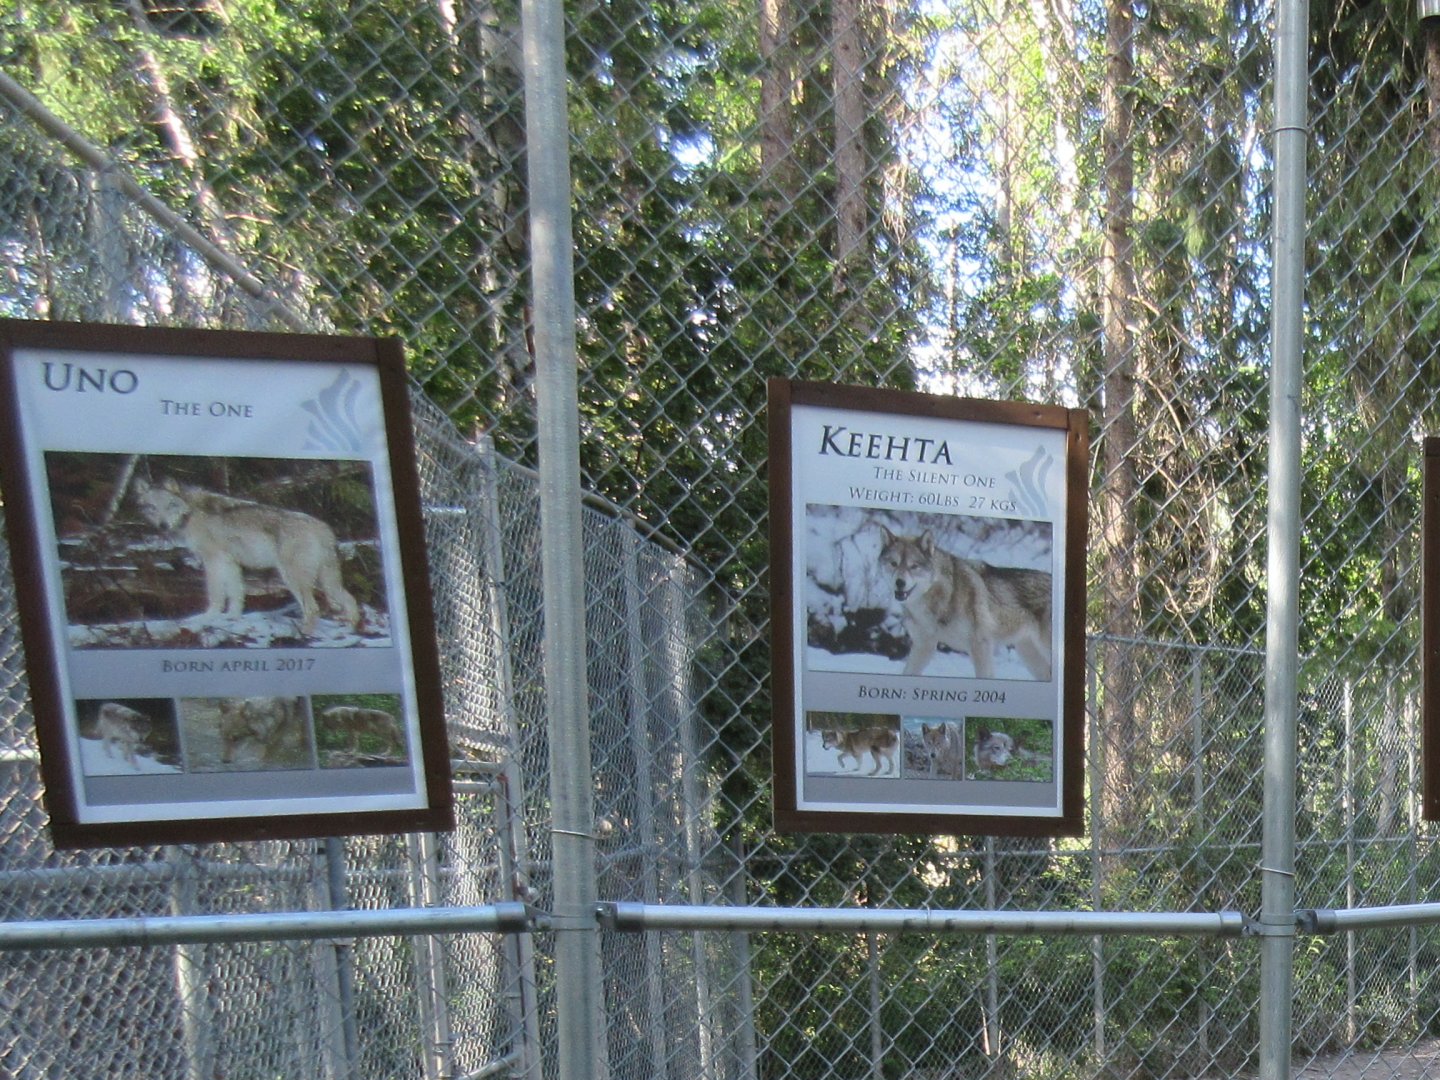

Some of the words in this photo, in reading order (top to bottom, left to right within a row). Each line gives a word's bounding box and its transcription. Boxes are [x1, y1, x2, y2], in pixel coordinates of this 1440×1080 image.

[42, 361, 139, 395] UNO
[160, 399, 200, 417] THE
[209, 401, 253, 418] ONE
[818, 425, 954, 465] KEEHTA
[873, 466, 903, 481] THE
[909, 469, 959, 486] SILENT
[963, 474, 996, 489] ONE
[849, 486, 914, 504] WEIGHT:
[918, 492, 960, 507] 60LBS
[968, 496, 986, 509] 27
[990, 499, 1017, 512] KGS
[162, 659, 213, 673] BORN
[221, 659, 269, 672] APRIL
[276, 658, 316, 672] 2017
[857, 685, 907, 700] BORN:
[912, 687, 968, 703] SPRING
[973, 690, 1007, 704] 2004
